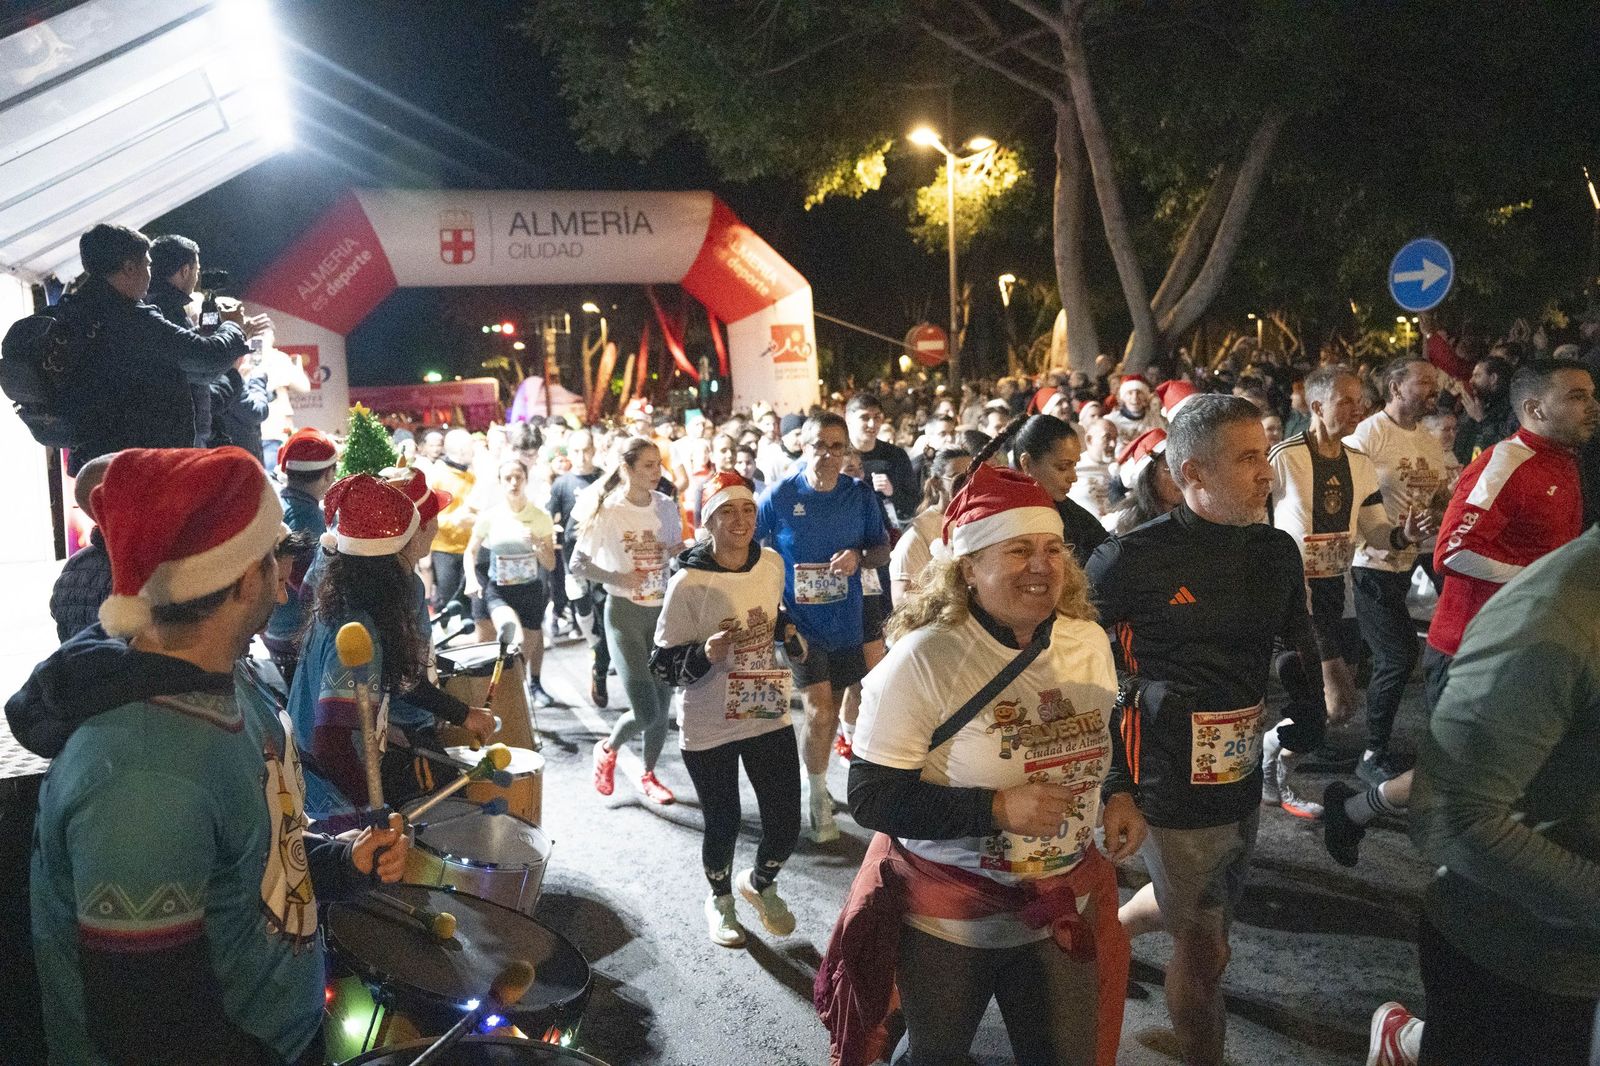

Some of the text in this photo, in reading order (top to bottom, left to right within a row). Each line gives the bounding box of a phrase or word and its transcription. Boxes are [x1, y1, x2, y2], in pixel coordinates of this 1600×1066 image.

[508, 205, 654, 237] ALMERÍA
[508, 242, 583, 260] CIUDAD
[326, 250, 372, 296] deporte
[726, 257, 769, 296] deporte
[807, 577, 837, 589] 1504
[740, 691, 777, 703] 2113
[1018, 708, 1106, 748] SILVESTRE
[1024, 741, 1063, 760] Ciudad
[1065, 741, 1077, 752] de
